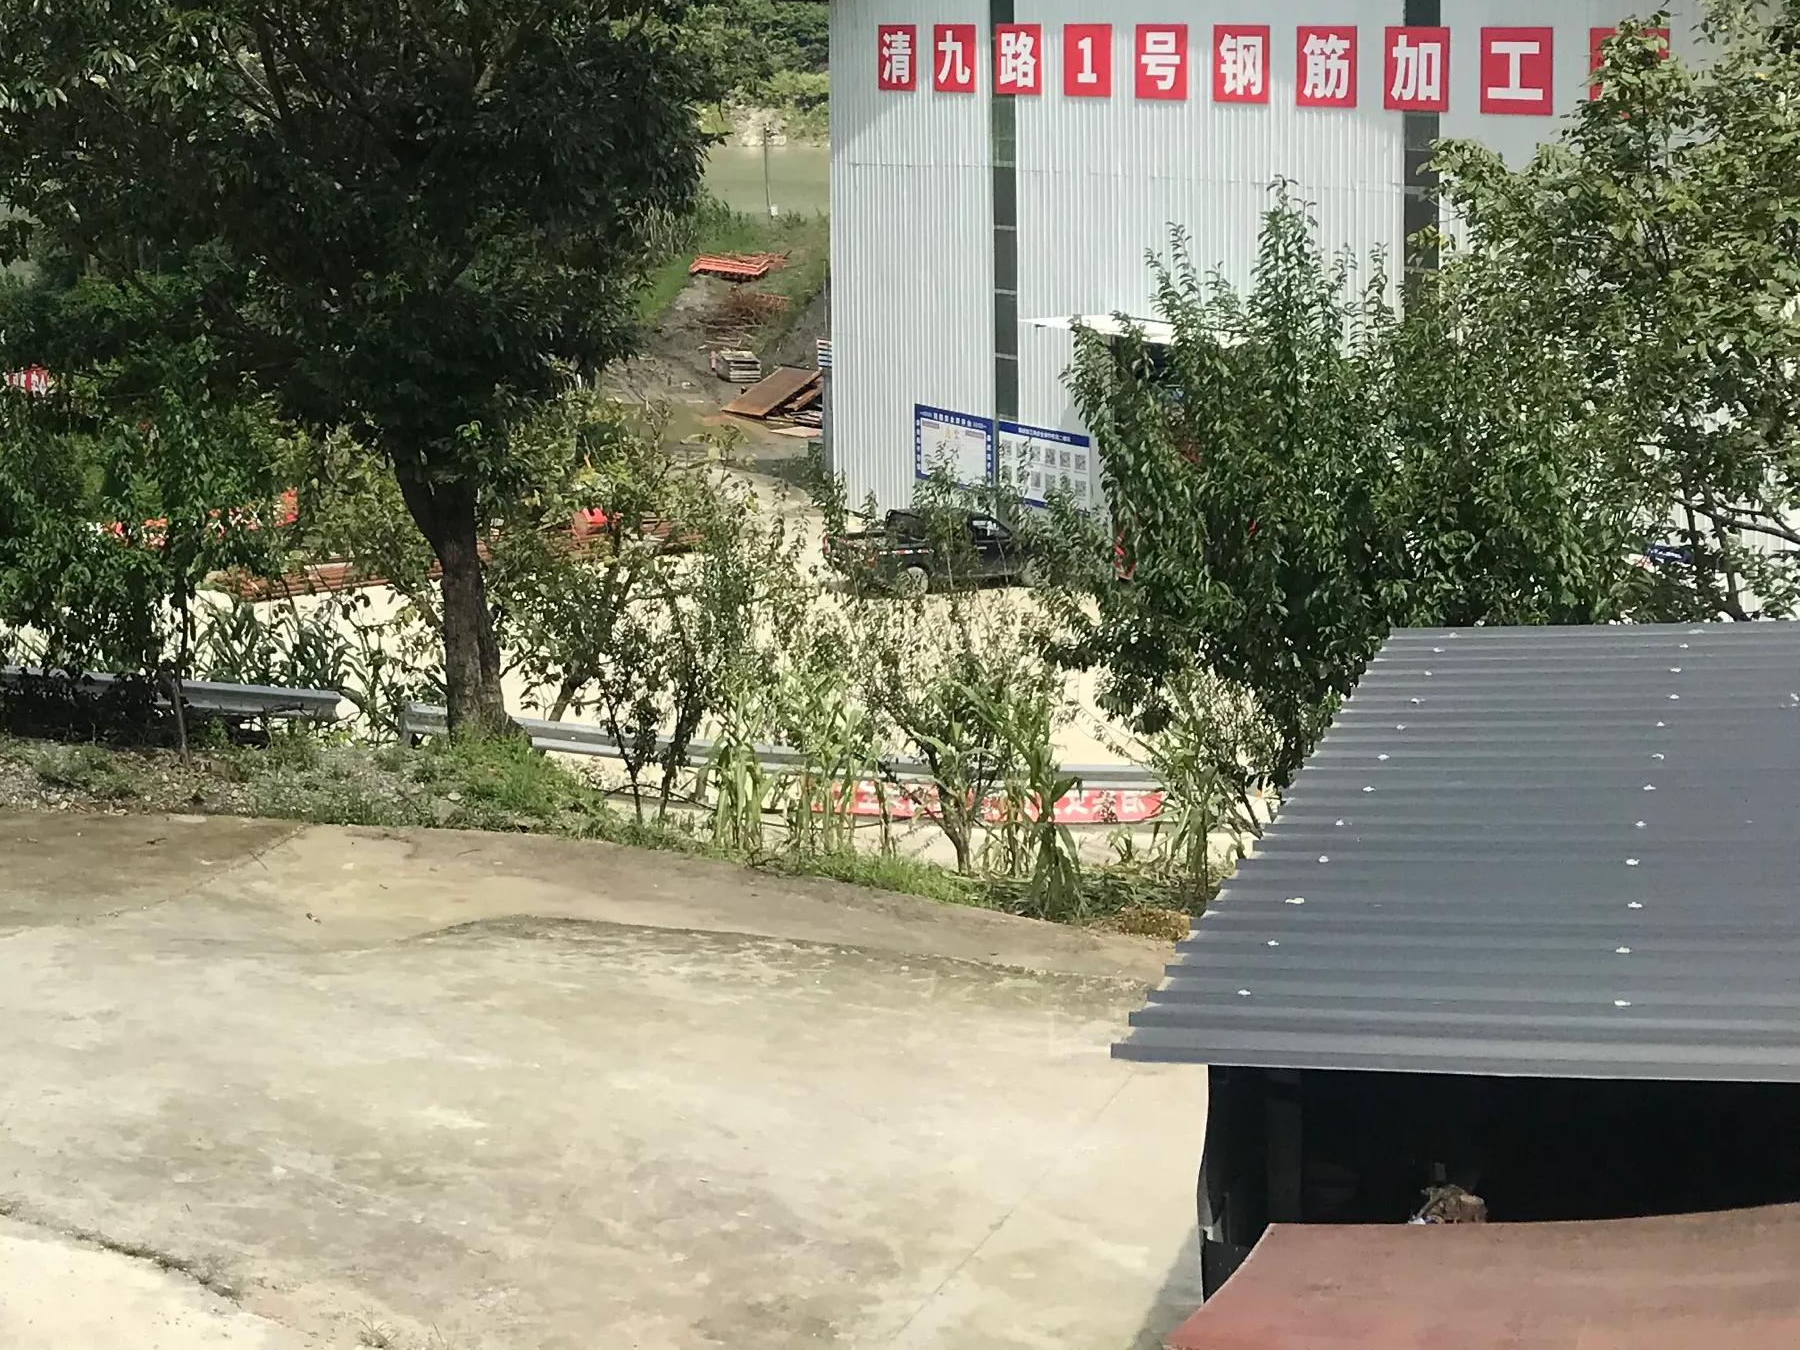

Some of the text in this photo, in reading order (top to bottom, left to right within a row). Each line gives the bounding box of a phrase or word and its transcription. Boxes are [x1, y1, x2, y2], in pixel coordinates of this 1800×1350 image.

[882, 30, 1660, 103] 清九路1号钢筋加工
